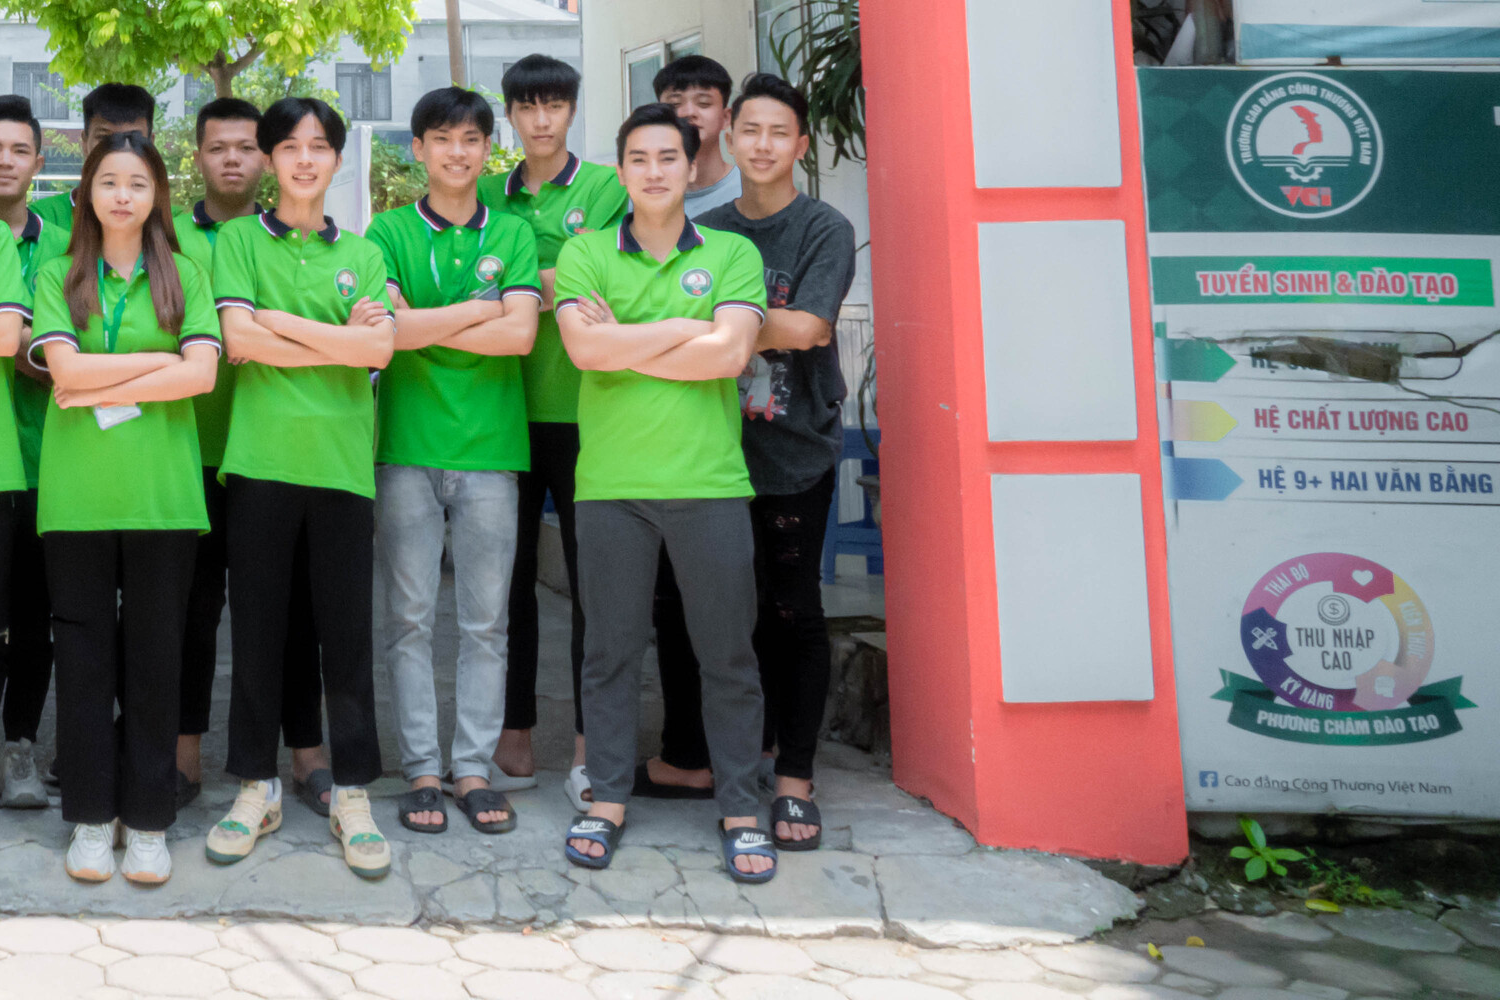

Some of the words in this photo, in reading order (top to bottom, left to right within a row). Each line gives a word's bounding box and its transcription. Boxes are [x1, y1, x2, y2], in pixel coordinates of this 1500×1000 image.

[1287, 82, 1318, 96] CÔNG
[1245, 104, 1263, 124] CAO
[1320, 87, 1358, 120] THƯƠNG
[1353, 117, 1371, 138] VIỆT
[1359, 141, 1372, 165] NAM
[1280, 186, 1332, 207] VCI
[1198, 263, 1270, 295] TUYỂN
[1275, 271, 1331, 295] SINH
[1336, 272, 1355, 295] &
[1358, 267, 1407, 297] ĐÀO
[1410, 273, 1457, 302] TẠO
[1254, 405, 1280, 433] HỆ
[1288, 402, 1341, 431] CHẤT
[1350, 409, 1419, 435] LƯỢNG
[1426, 411, 1469, 433] CAO
[1258, 465, 1286, 494] HỆ
[1294, 470, 1322, 490] 9+
[1330, 471, 1368, 491] HAI
[1375, 468, 1422, 492] VĂN
[1429, 464, 1494, 494] BẰNG
[1296, 627, 1325, 649] THU
[1333, 627, 1375, 652] NHẬP
[1321, 651, 1353, 671] CAO
[1257, 709, 1320, 733] PHƯƠNG
[1324, 713, 1370, 736] CHÂM
[1373, 714, 1406, 734] ĐÀO
[1407, 714, 1440, 736] TẠO
[1224, 774, 1250, 788] Cao
[1254, 774, 1290, 793] đẳng
[1292, 776, 1329, 794] Công
[1331, 778, 1386, 796] Thương
[1388, 780, 1416, 794] Việt
[1419, 782, 1453, 795] Nam
[579, 820, 605, 830] NIKE
[741, 831, 766, 843] NIKE
